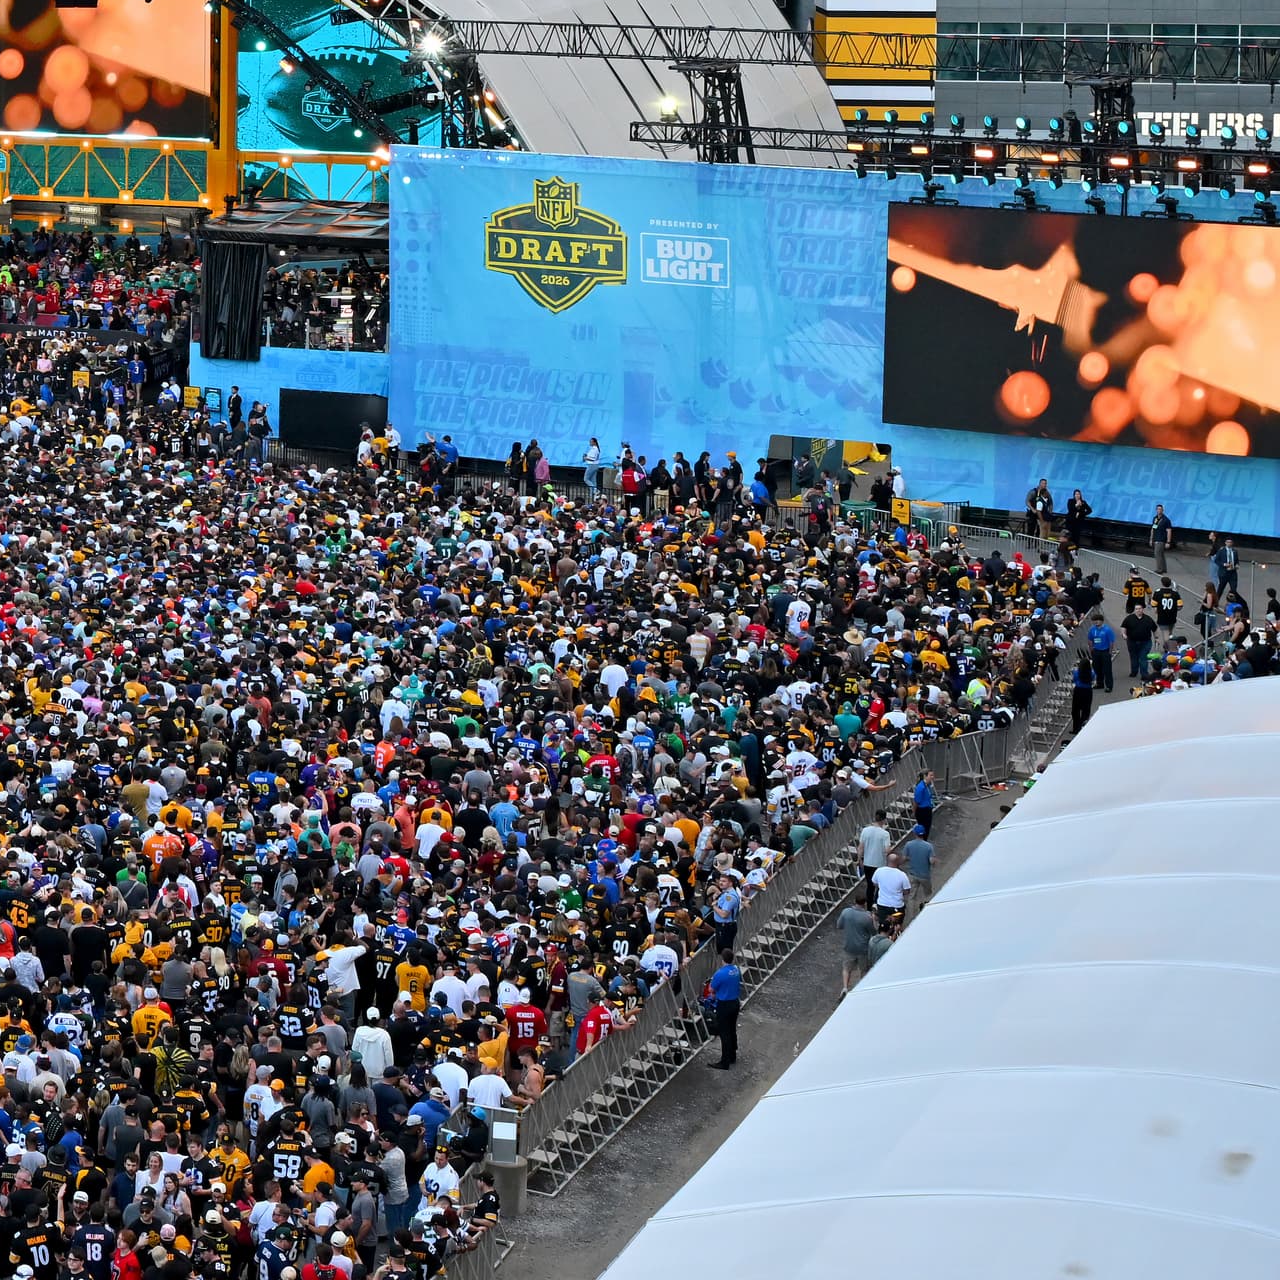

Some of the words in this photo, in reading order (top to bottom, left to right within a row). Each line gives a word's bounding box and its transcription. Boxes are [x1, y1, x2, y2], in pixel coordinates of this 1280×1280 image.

[306, 104, 348, 116] DRAT
[1133, 112, 1264, 137] TEELERS
[539, 201, 570, 218] NFL
[649, 219, 703, 229] PRESENTED
[497, 236, 613, 266] DRAFT
[656, 239, 713, 261] BUD
[646, 258, 724, 282] LIGHT
[541, 275, 570, 286] 2026
[39, 329, 87, 337] MARROTT
[1161, 598, 1174, 610] 90
[337, 699, 344, 711] 8
[821, 747, 836, 762] 86
[779, 796, 797, 812] 95
[10, 908, 28, 927] 43
[206, 927, 222, 943] 90
[612, 939, 629, 956] 90
[376, 962, 389, 979] 97
[218, 976, 230, 991] 90
[279, 1016, 302, 1037] 32
[517, 1022, 534, 1039] 15
[190, 1033, 199, 1049] 9
[276, 1143, 300, 1151] LAMBERT
[273, 1155, 301, 1179] 58
[30, 1245, 49, 1266] 10
[86, 1244, 102, 1261] 18
